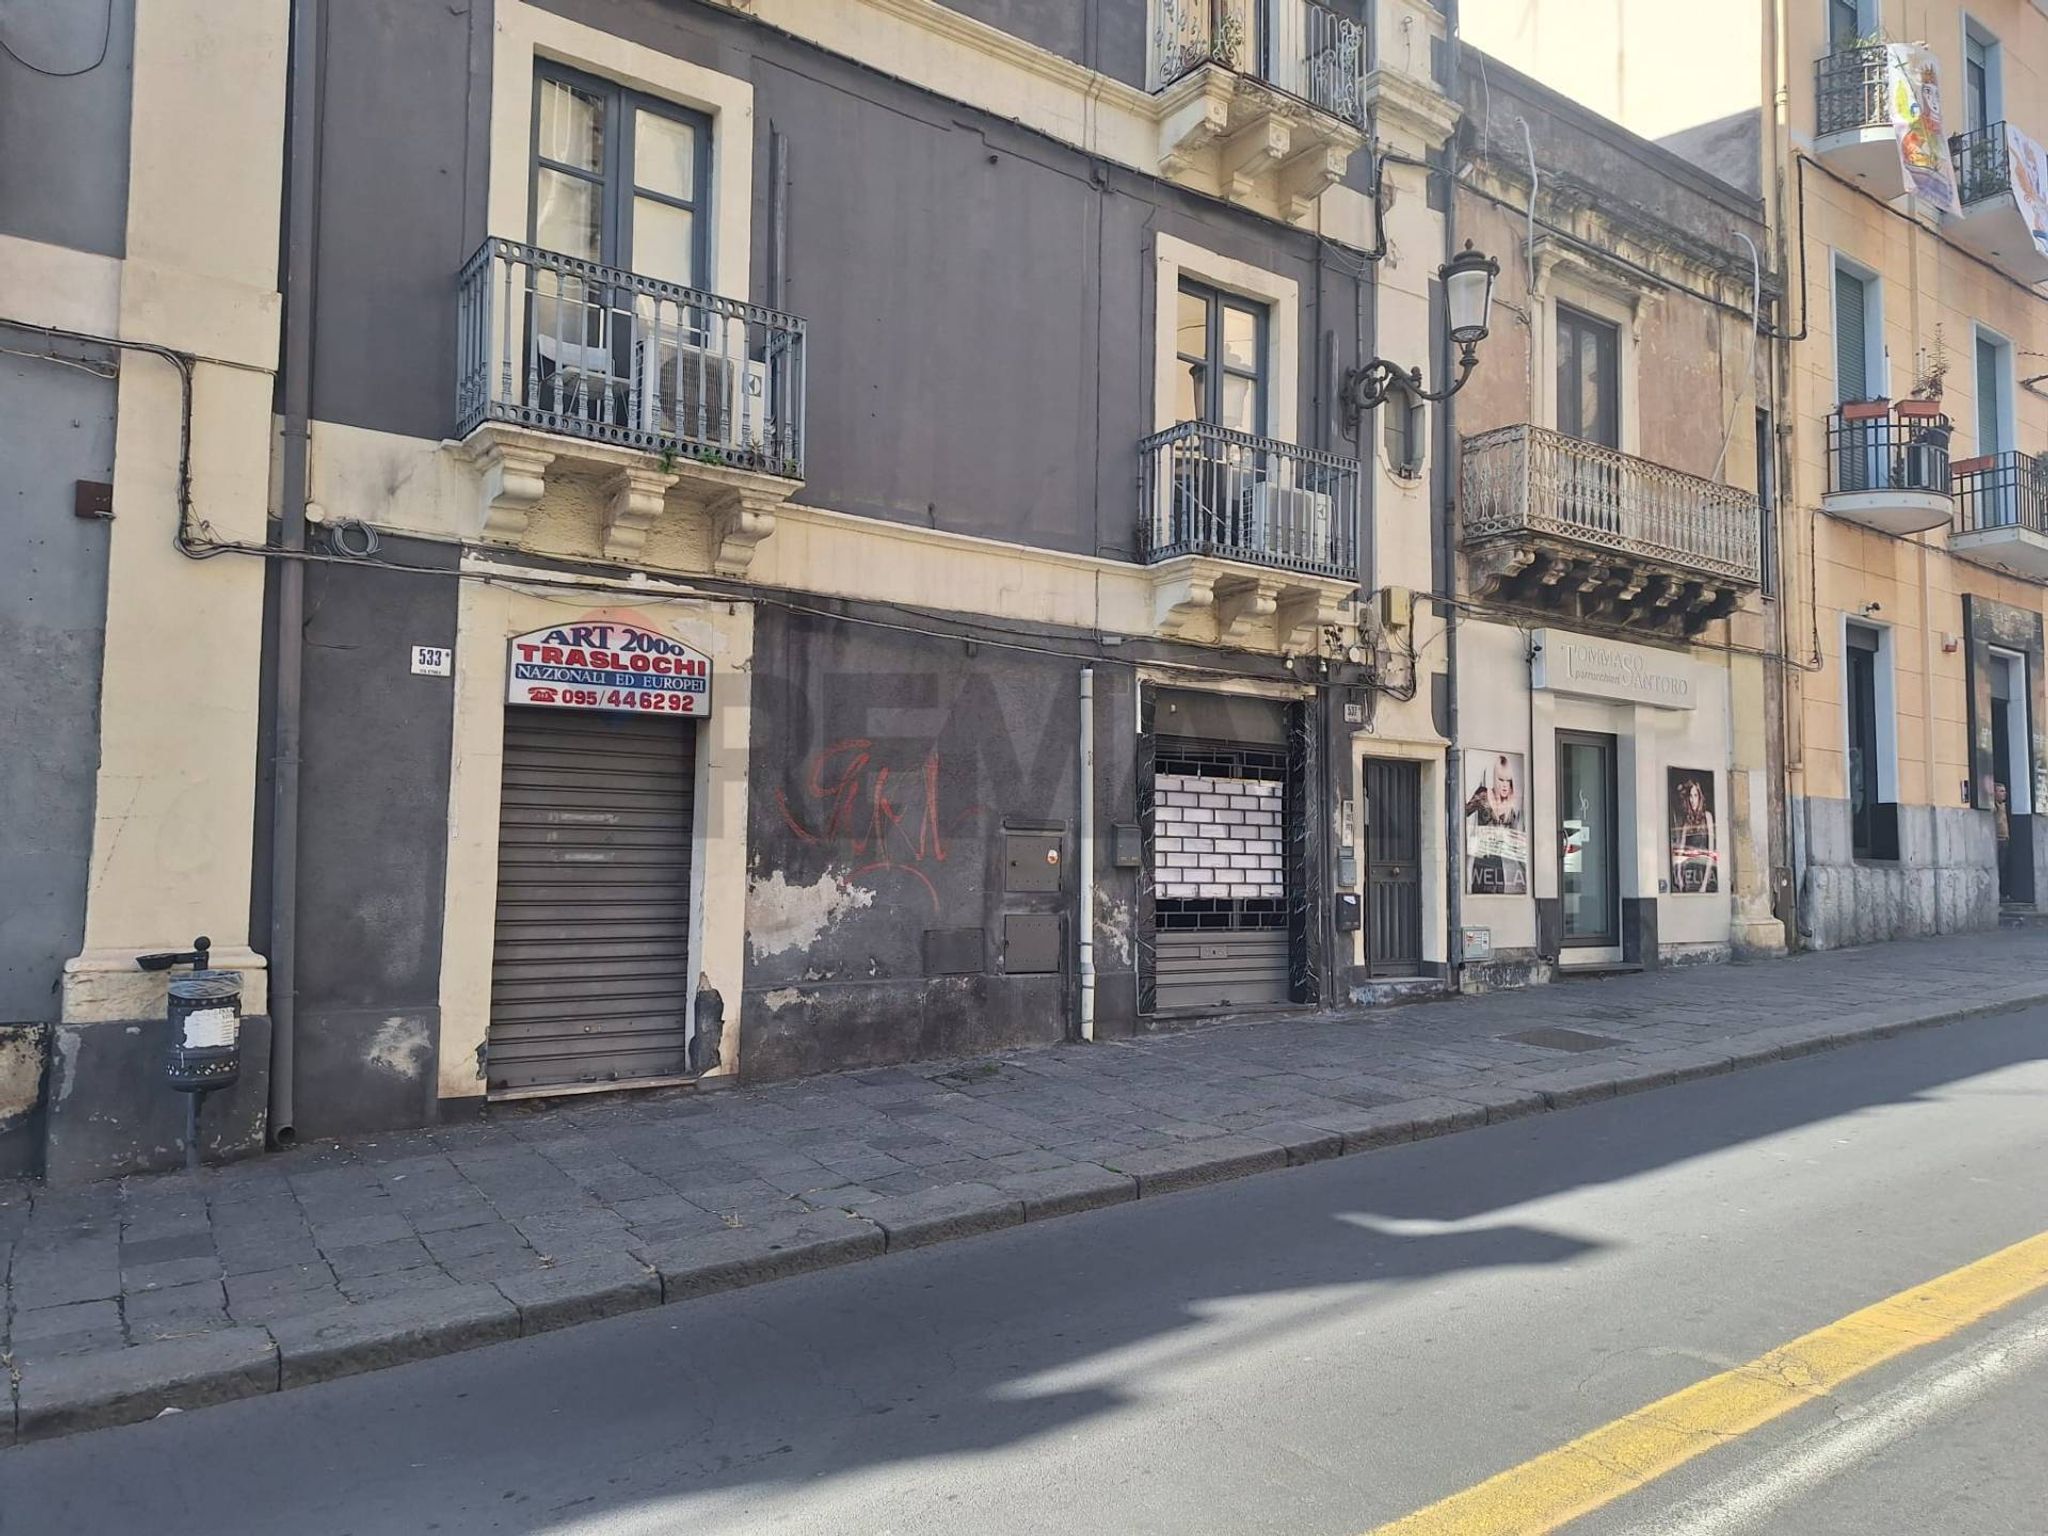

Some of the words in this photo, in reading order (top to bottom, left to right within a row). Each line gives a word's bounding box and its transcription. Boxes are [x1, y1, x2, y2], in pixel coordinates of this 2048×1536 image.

[541, 626, 615, 649] ART
[620, 628, 685, 656] 2000
[419, 648, 442, 667] 533
[517, 644, 706, 676] TRASLOCHI
[517, 664, 606, 684] NAZIONALI
[615, 674, 635, 686] ED
[643, 677, 705, 692] EUROPEI
[1470, 867, 1526, 886] WELLA
